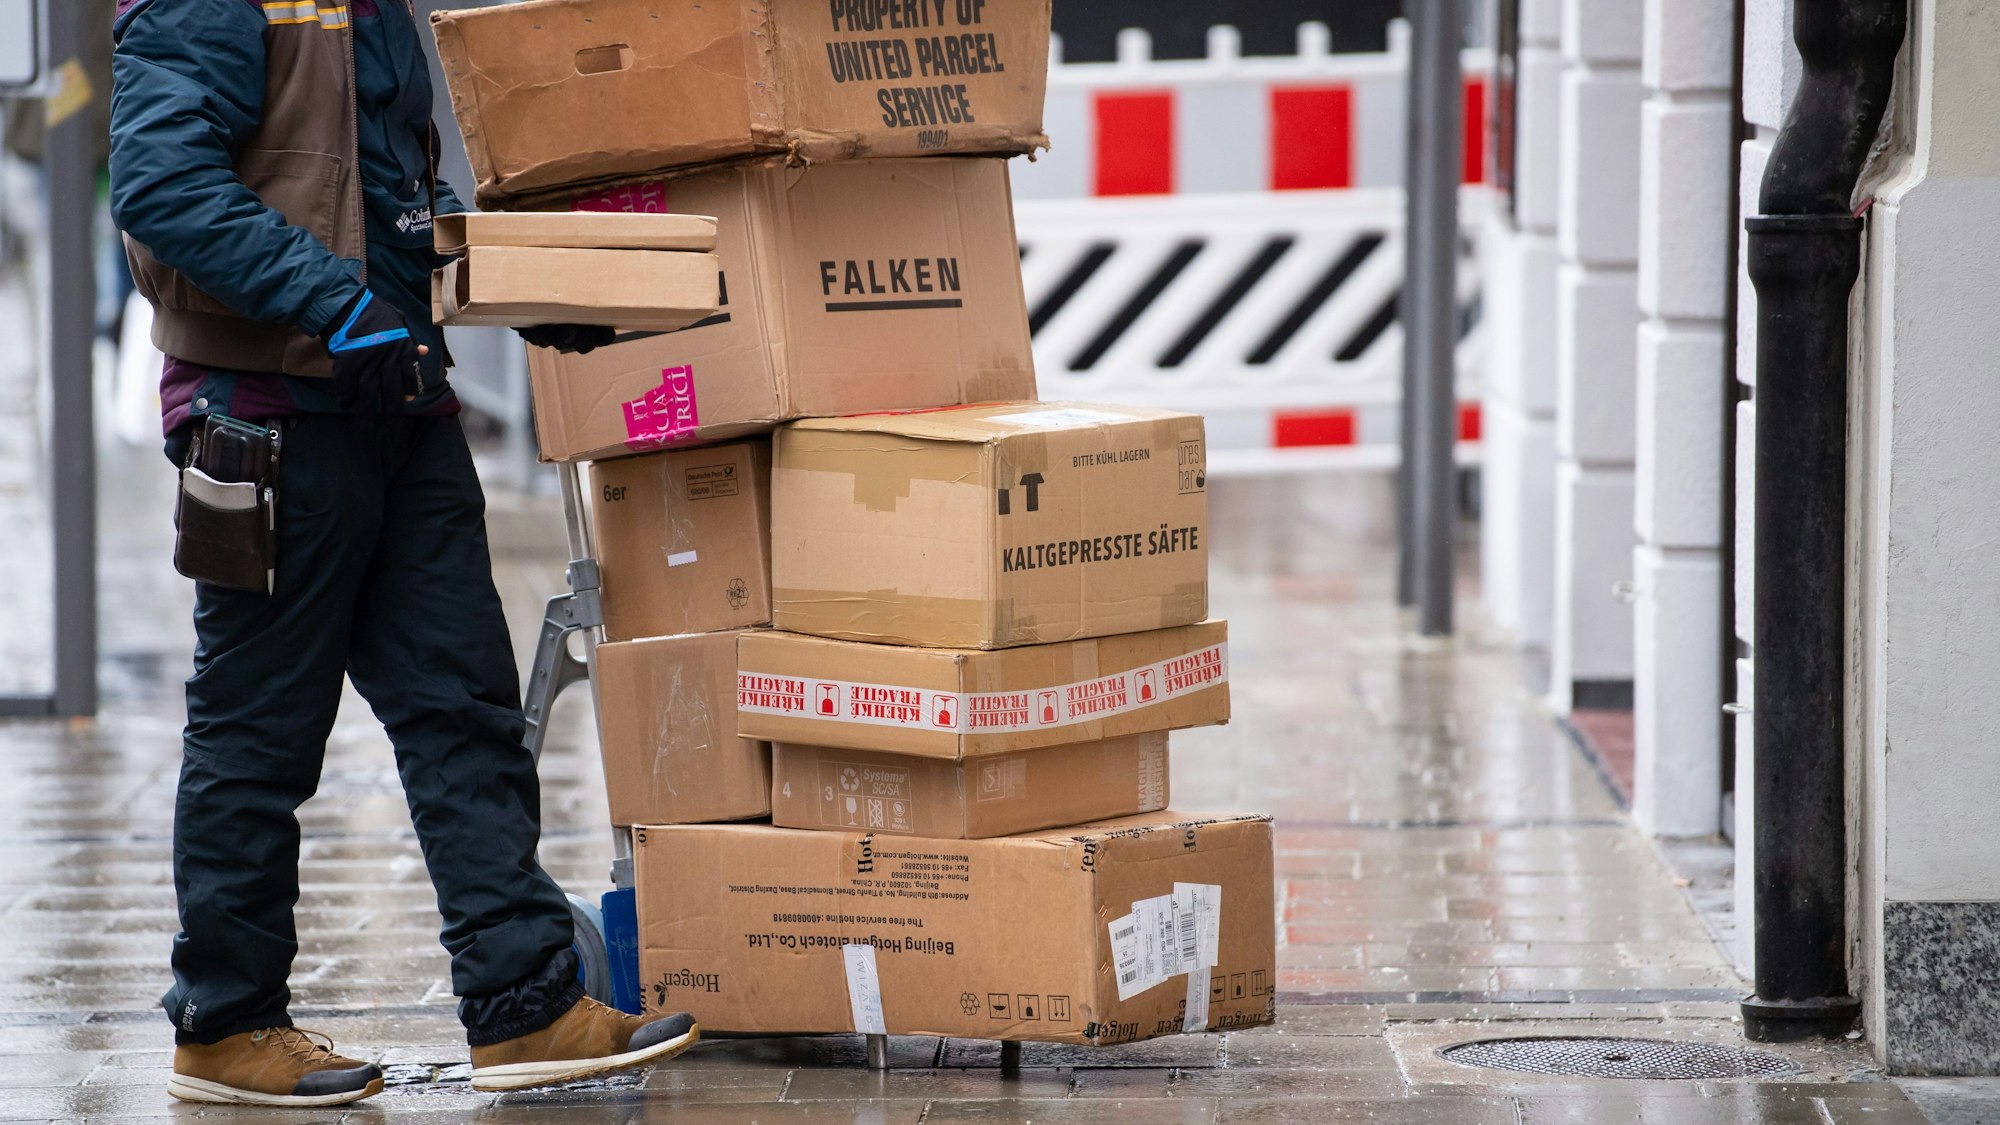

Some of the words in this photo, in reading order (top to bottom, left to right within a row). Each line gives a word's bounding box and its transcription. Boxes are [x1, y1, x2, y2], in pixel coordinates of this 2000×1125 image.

[830, 0, 947, 32] PROPERTY
[956, 0, 985, 26] OF
[826, 38, 913, 84] UNITED
[915, 33, 1004, 77] PARCEL
[877, 84, 975, 129] SERVICE
[917, 129, 949, 149] 199401
[819, 257, 961, 296] FALKEN
[1072, 454, 1094, 468] BITTE
[1096, 451, 1118, 465] KÜHL
[1119, 448, 1150, 463] LAGERN
[603, 484, 627, 502] 6er
[1003, 532, 1142, 573] KALTGEPRESSTE
[1148, 523, 1198, 556] SÄFTE
[1163, 647, 1221, 677] FRAGILE
[738, 675, 805, 695] FRAGILE
[1066, 675, 1126, 700] FRAGILE
[1164, 662, 1223, 696] KŘEHKÉ
[738, 691, 805, 713] KŘEHKÉ
[851, 686, 921, 706] FRAGILE
[969, 694, 1029, 711] FRAGILE
[851, 702, 921, 723] KŘEHKÉ
[1068, 691, 1128, 721] KŘEHKÉ
[969, 711, 1029, 729] KŘEHKÉ
[782, 781, 791, 799] 4
[824, 785, 834, 801] 3
[872, 782, 900, 796] SC/SA
[940, 854, 969, 862] Website:
[954, 864, 969, 872] Fax:
[851, 879, 873, 887] China.
[873, 880, 886, 888] P.R.
[913, 880, 939, 890] Beijing,
[945, 873, 969, 882] Phone:
[728, 885, 755, 893] District,
[779, 885, 797, 894] Base,
[798, 886, 834, 895] Biomedical
[834, 887, 856, 896] Street,
[857, 889, 878, 897] Tianfu
[885, 890, 896, 898] No.
[897, 889, 927, 899] Building,
[825, 914, 855, 925] hotline
[856, 915, 887, 925] service
[888, 916, 906, 927] free
[907, 917, 924, 928] The
[744, 932, 797, 949] Co.,Ltd.
[905, 936, 955, 955] Beijing
[663, 968, 721, 993] Hotgen
[856, 961, 873, 1024] WIZARD
